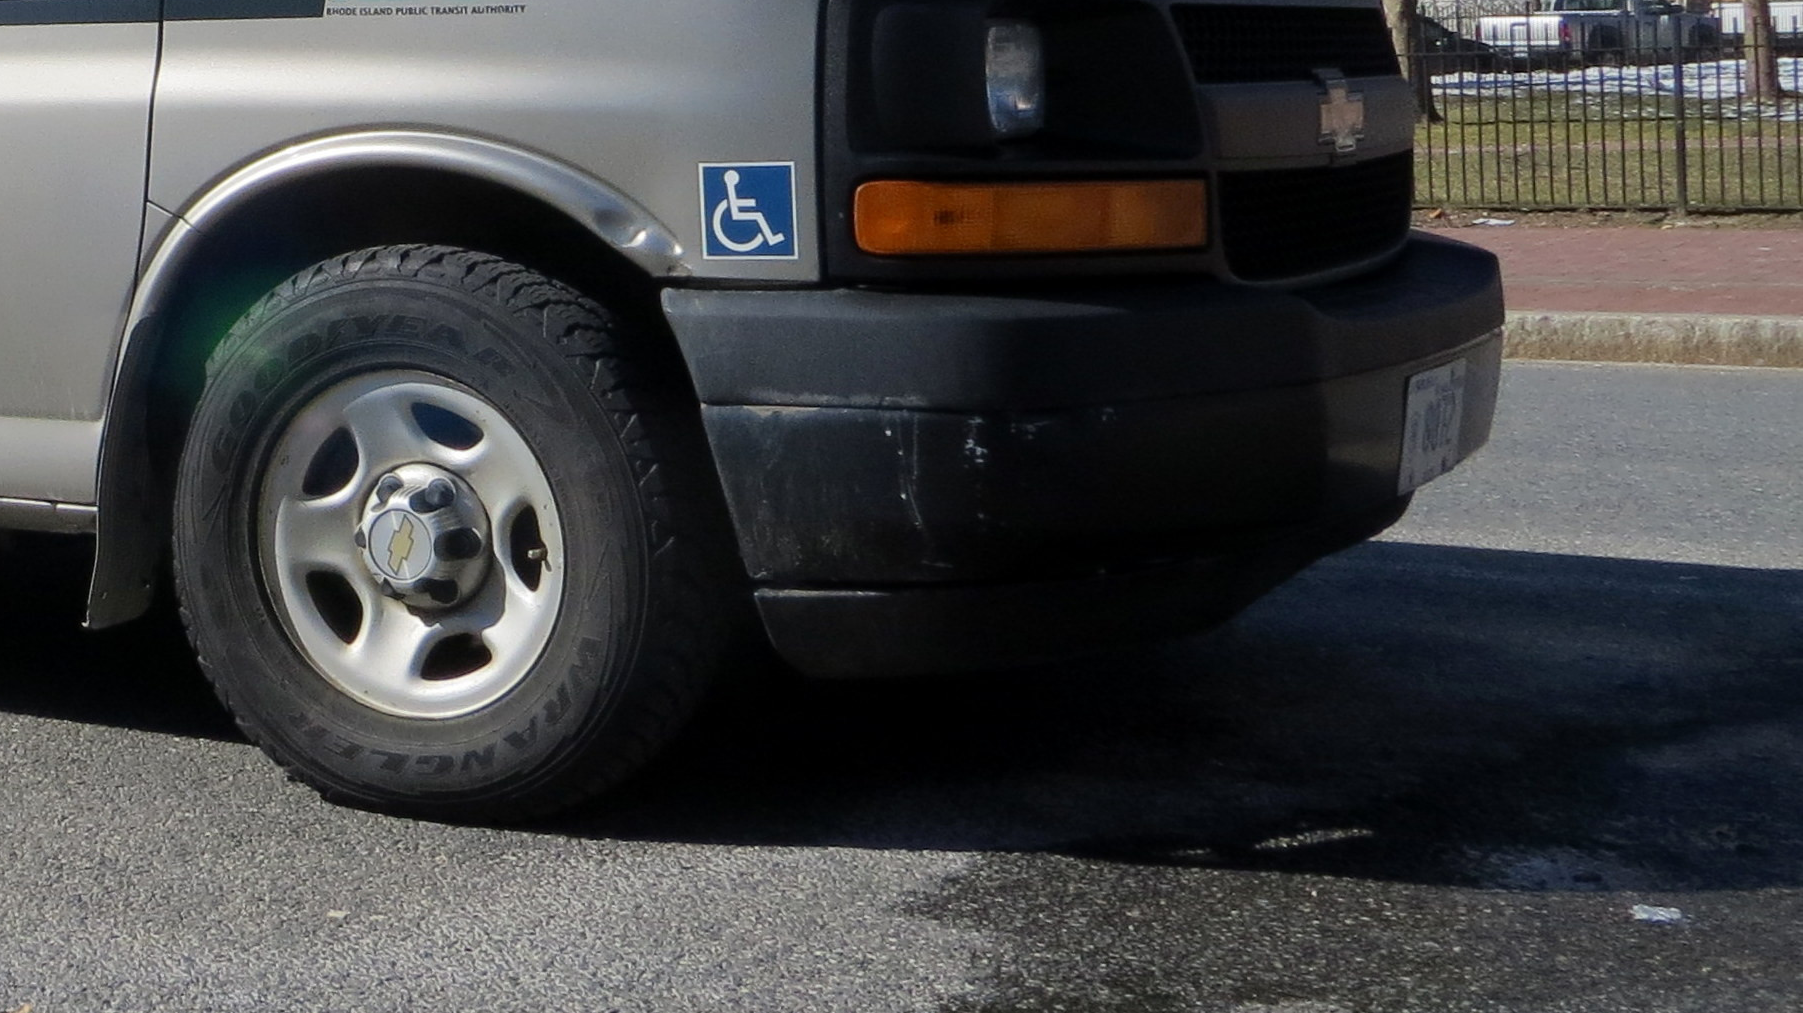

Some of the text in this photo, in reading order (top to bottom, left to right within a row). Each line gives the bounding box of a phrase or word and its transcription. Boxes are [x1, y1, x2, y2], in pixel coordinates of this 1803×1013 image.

[326, 4, 526, 17] RHODE ISLAND PUBLIC TRANSIT AUTHORITY
